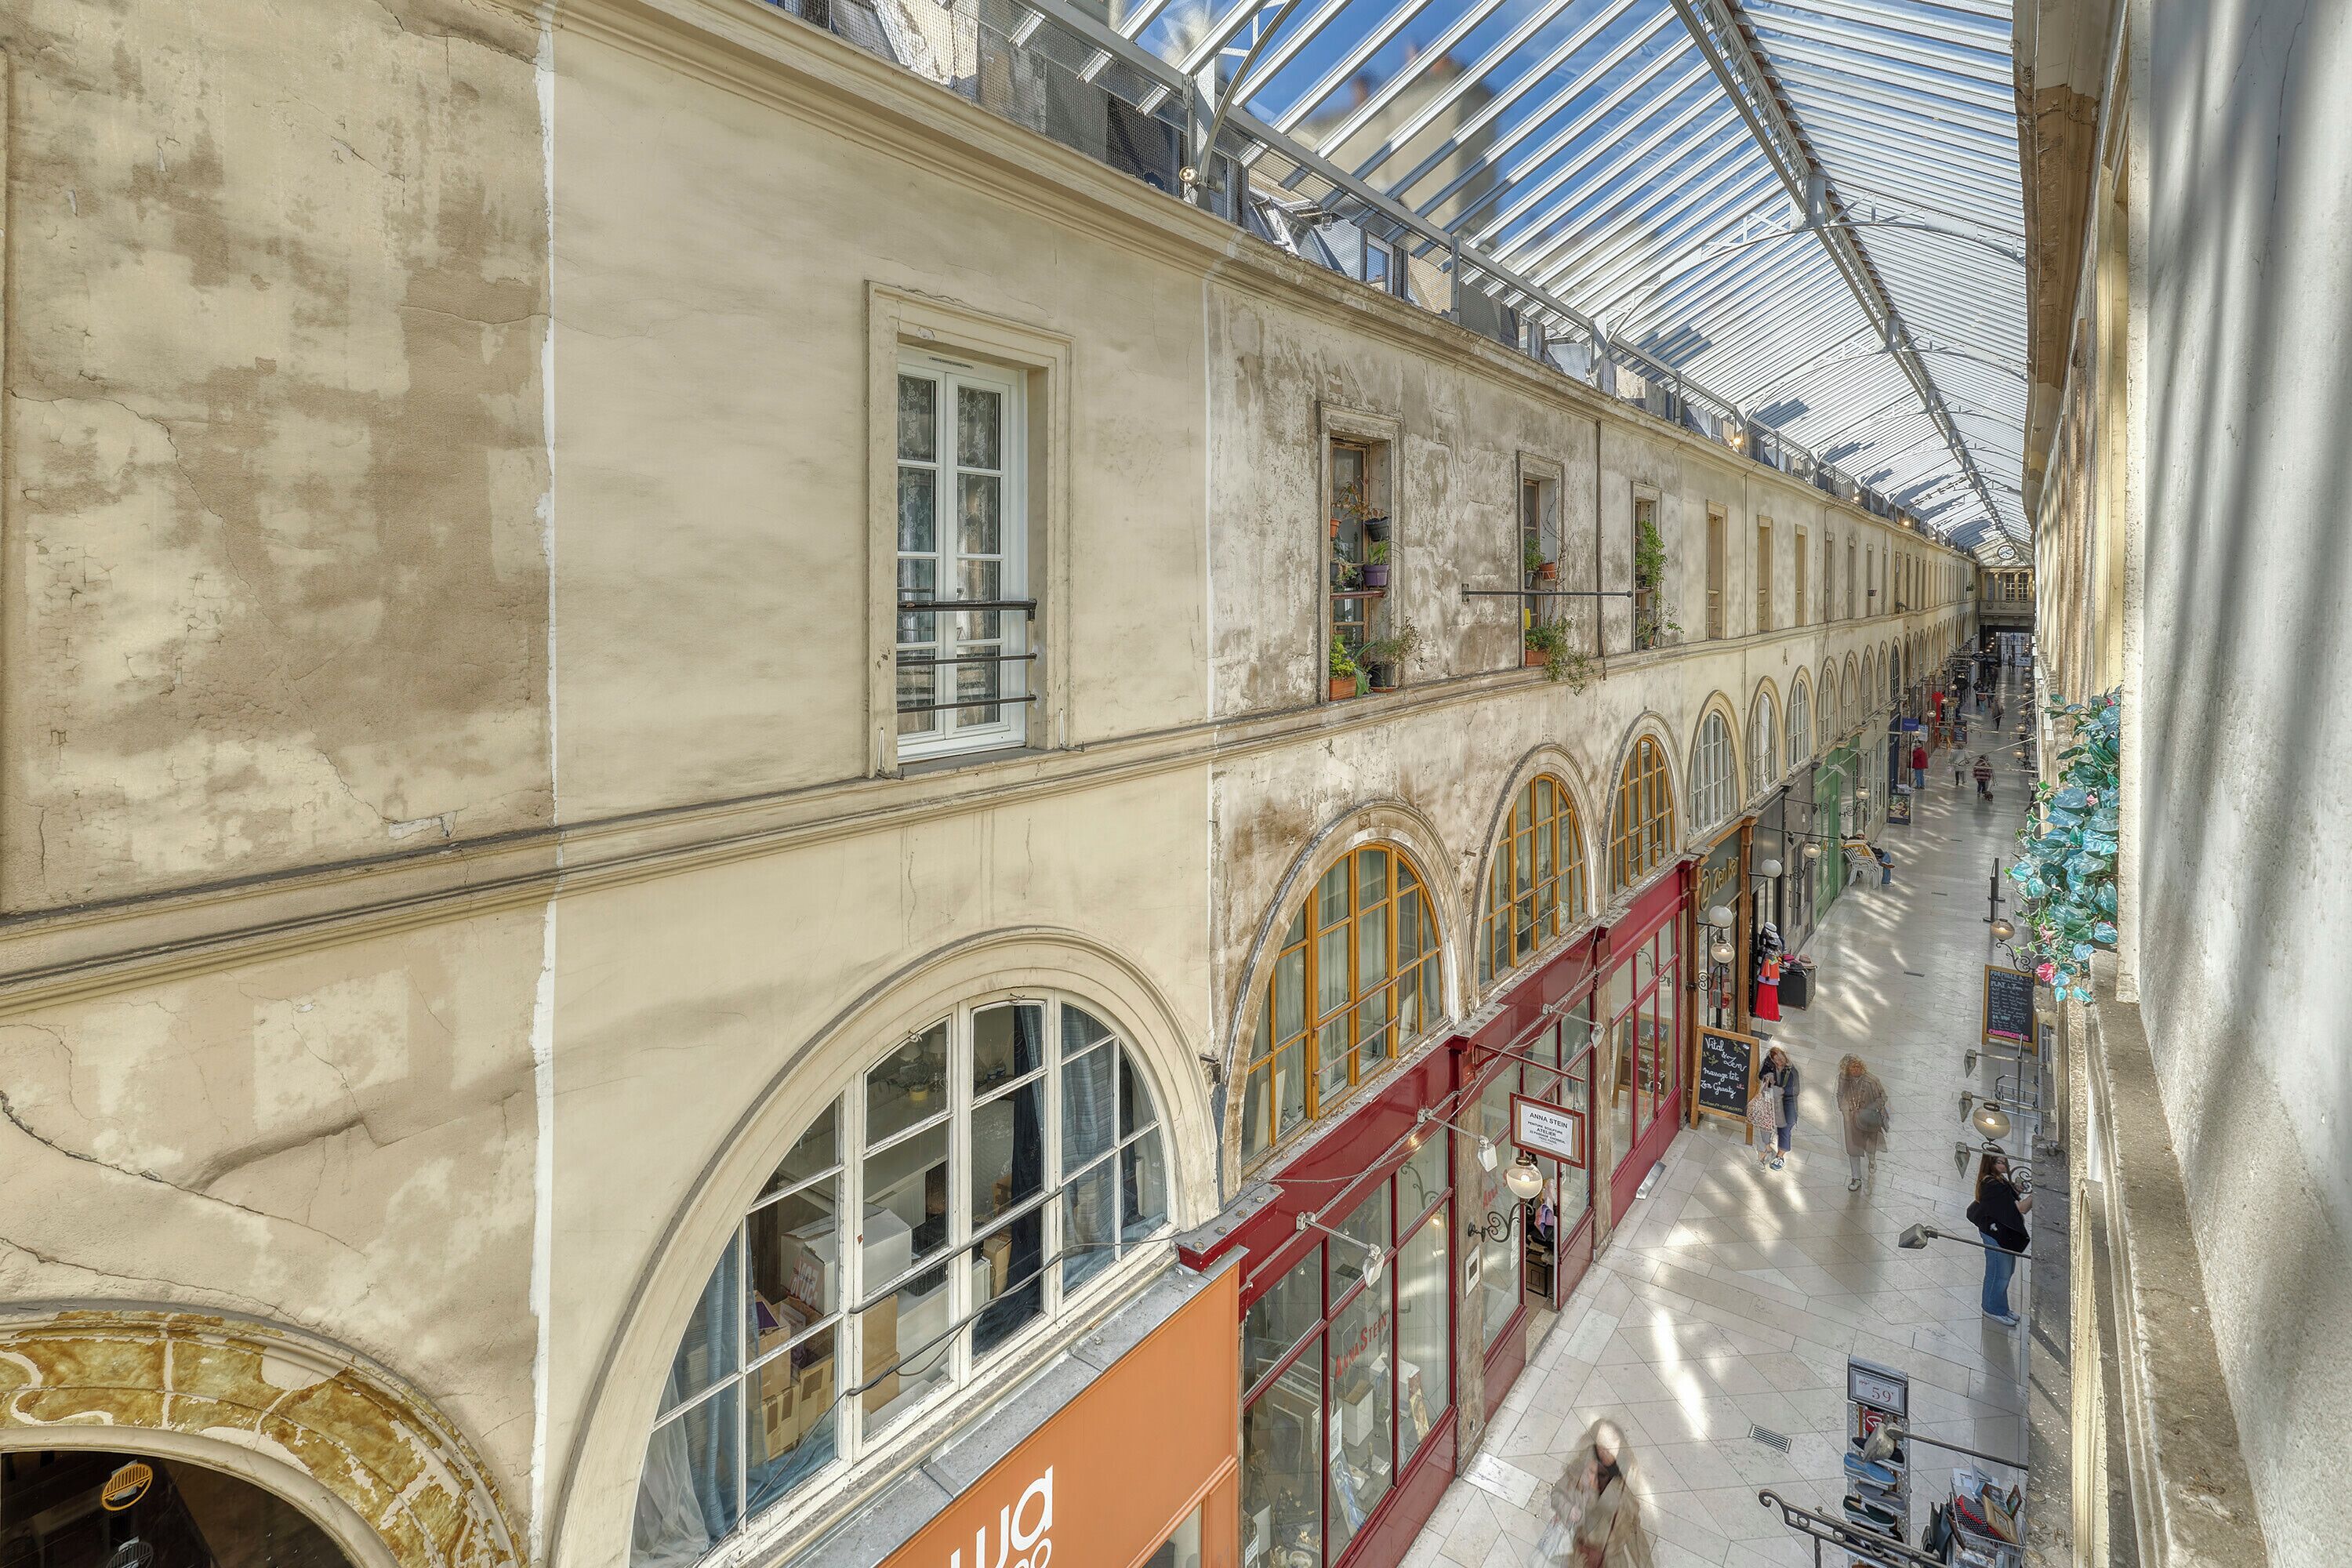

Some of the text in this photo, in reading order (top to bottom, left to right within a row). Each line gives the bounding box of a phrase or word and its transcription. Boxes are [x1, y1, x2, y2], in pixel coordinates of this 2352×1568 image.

[1712, 866, 1726, 894] Zen
[1705, 1037, 1725, 1051] Vital
[1723, 1055, 1747, 1072] Zen
[1530, 1112, 1568, 1128] ANNA STEIN
[1537, 1127, 1556, 1137] ATELIER
